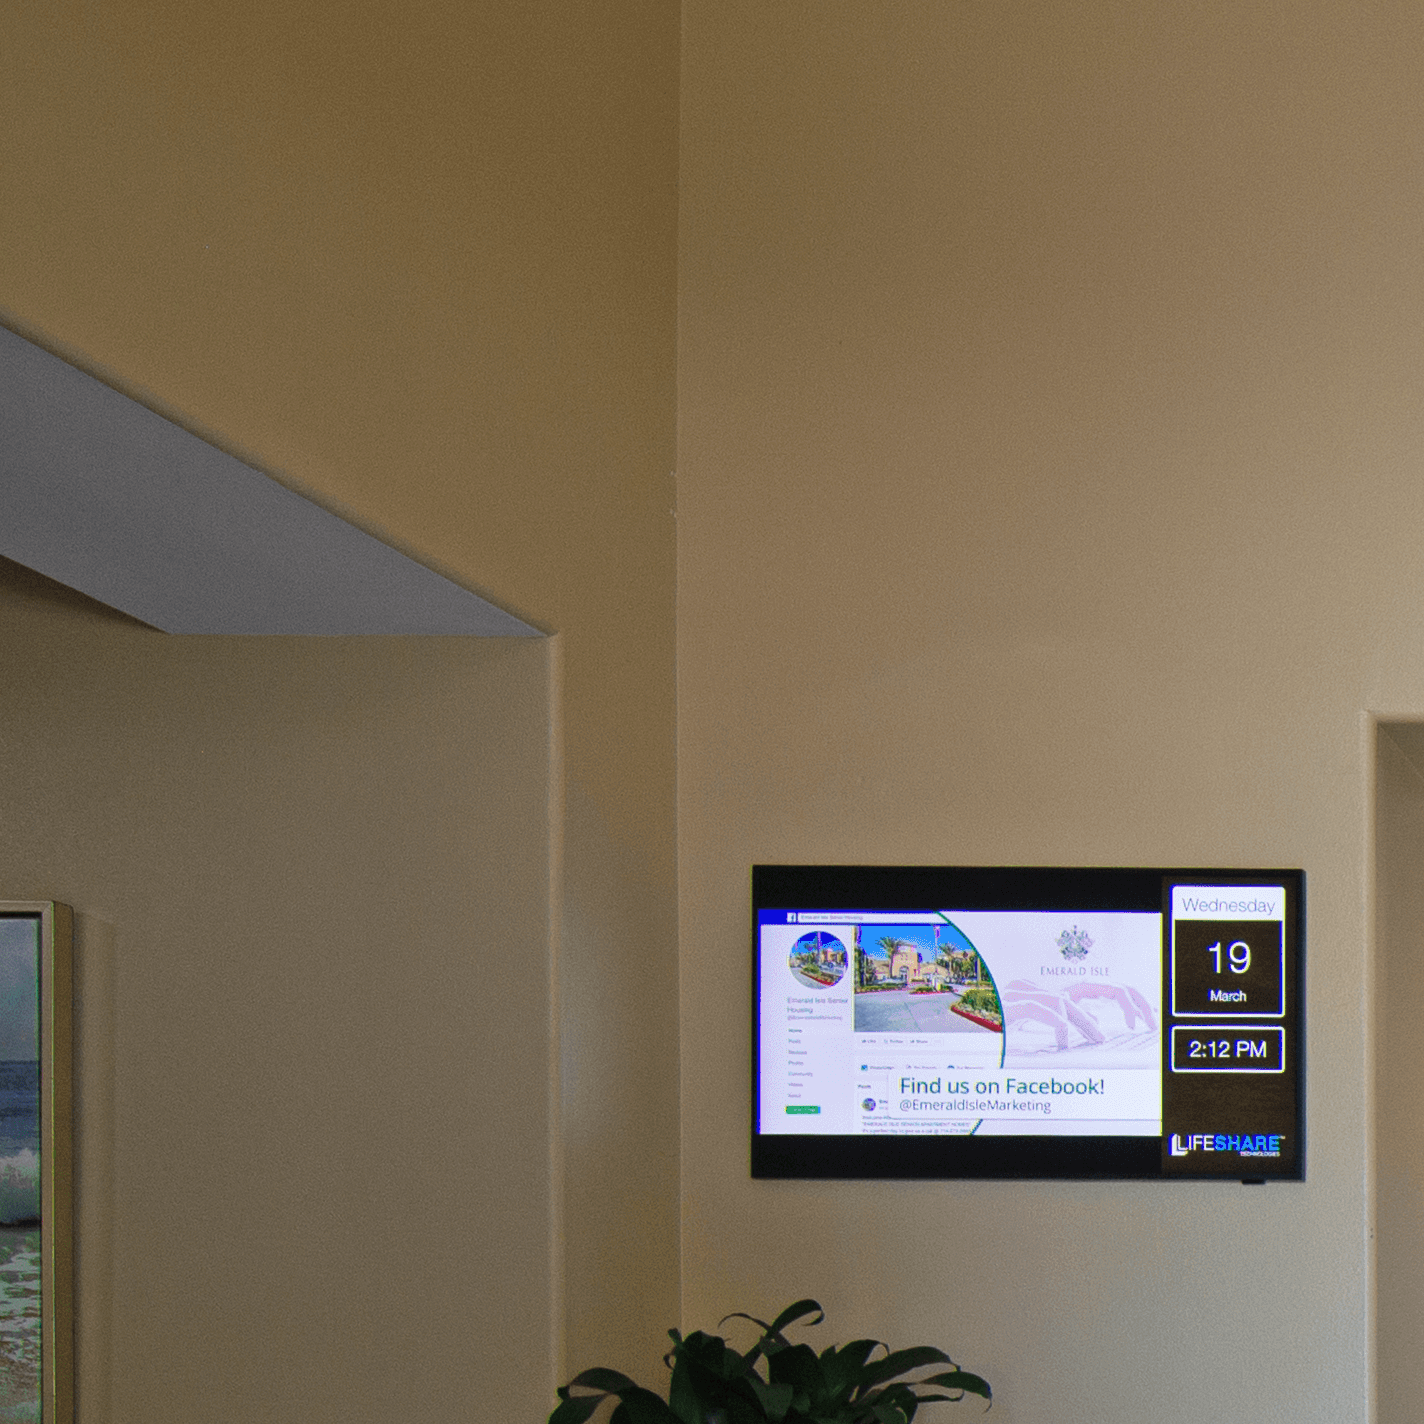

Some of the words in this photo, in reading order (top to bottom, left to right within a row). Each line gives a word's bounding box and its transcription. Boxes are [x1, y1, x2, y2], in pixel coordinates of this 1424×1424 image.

[1182, 898, 1276, 916] Wednesday
[1206, 940, 1251, 974] 19
[1040, 966, 1087, 976] EMERALD
[1090, 966, 1109, 976] ISLE
[1208, 988, 1247, 1002] March
[1188, 1039, 1231, 1058] 2:12
[1234, 1039, 1267, 1058] PM
[900, 1076, 941, 1095] Find
[948, 1080, 970, 1095] us
[975, 1080, 1000, 1095] on
[1006, 1077, 1105, 1095] Facebook!
[899, 1098, 1052, 1115] @EmeraldIsleMarketing
